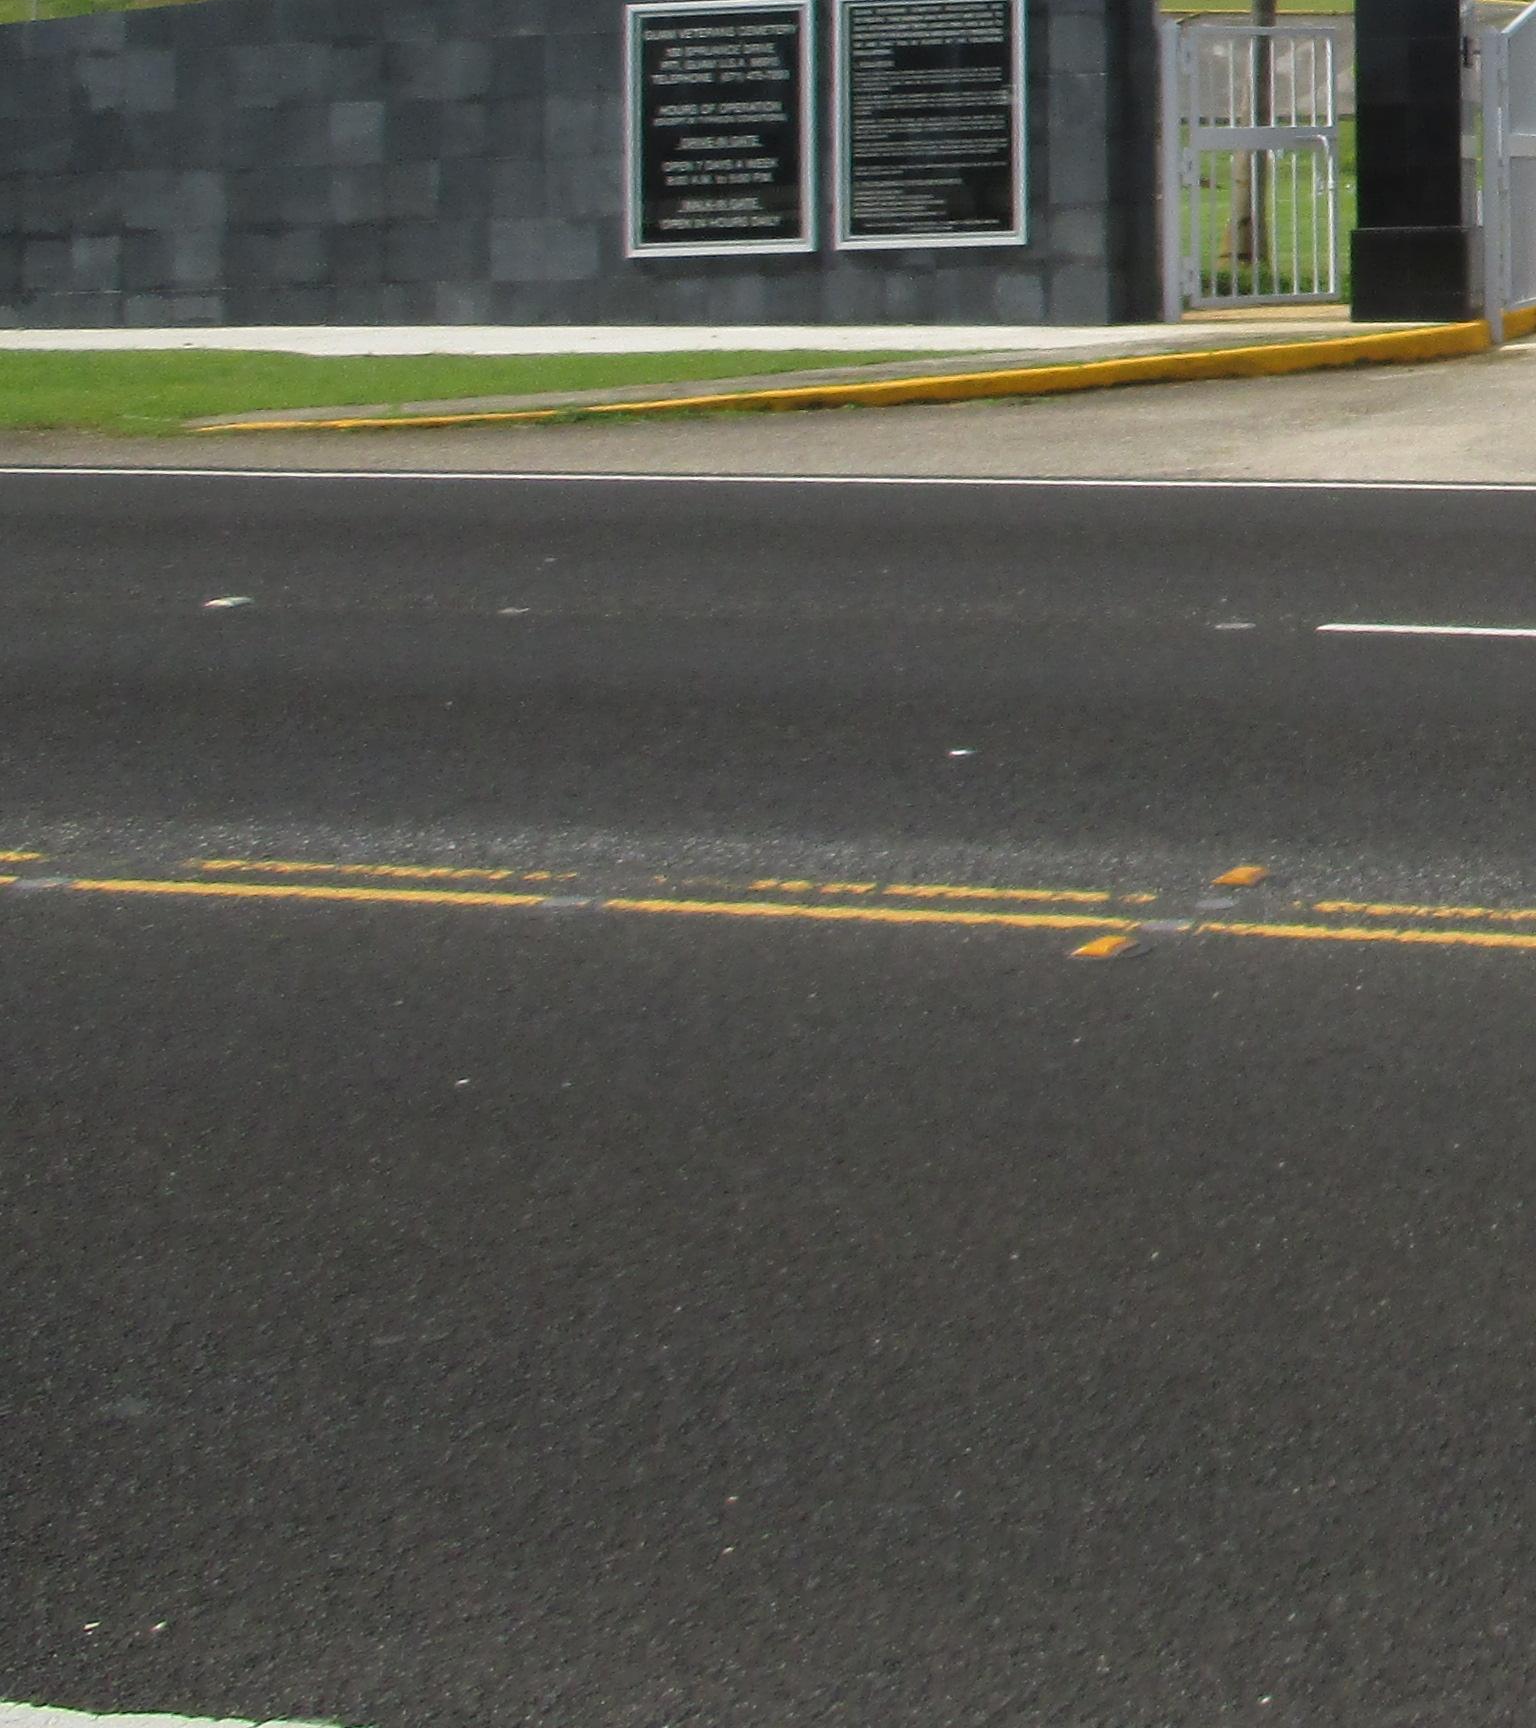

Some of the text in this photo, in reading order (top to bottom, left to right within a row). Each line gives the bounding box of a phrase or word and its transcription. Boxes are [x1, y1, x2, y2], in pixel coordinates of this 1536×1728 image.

[679, 27, 736, 40] VETERANS
[737, 24, 796, 36] CEMETERY
[659, 101, 782, 115] HOURS OF OPERATION
